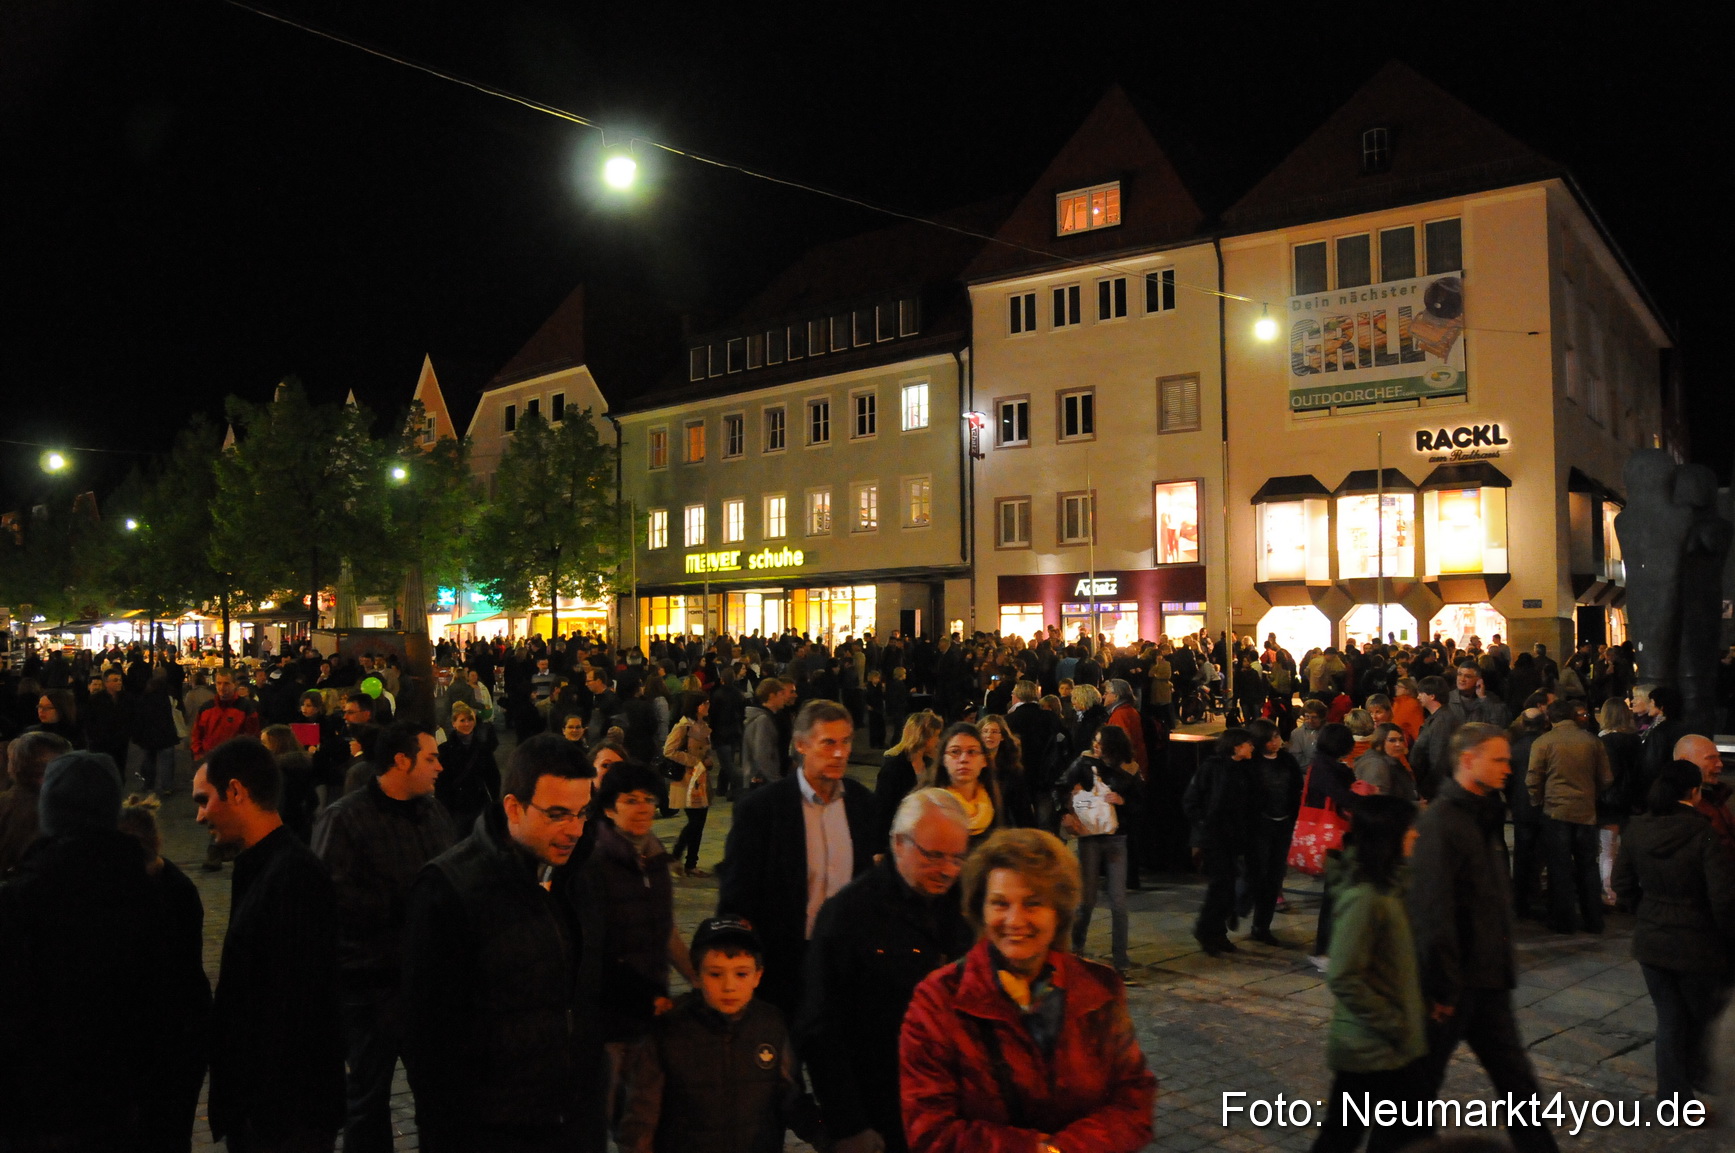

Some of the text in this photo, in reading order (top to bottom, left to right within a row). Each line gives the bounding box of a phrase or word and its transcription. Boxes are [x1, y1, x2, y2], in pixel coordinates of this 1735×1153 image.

[1292, 285, 1417, 311] Dein nächster
[1291, 306, 1426, 376] GRILL
[1416, 424, 1508, 452] RACKL
[1429, 449, 1501, 463] am Rathaus
[748, 546, 804, 569] schuhe
